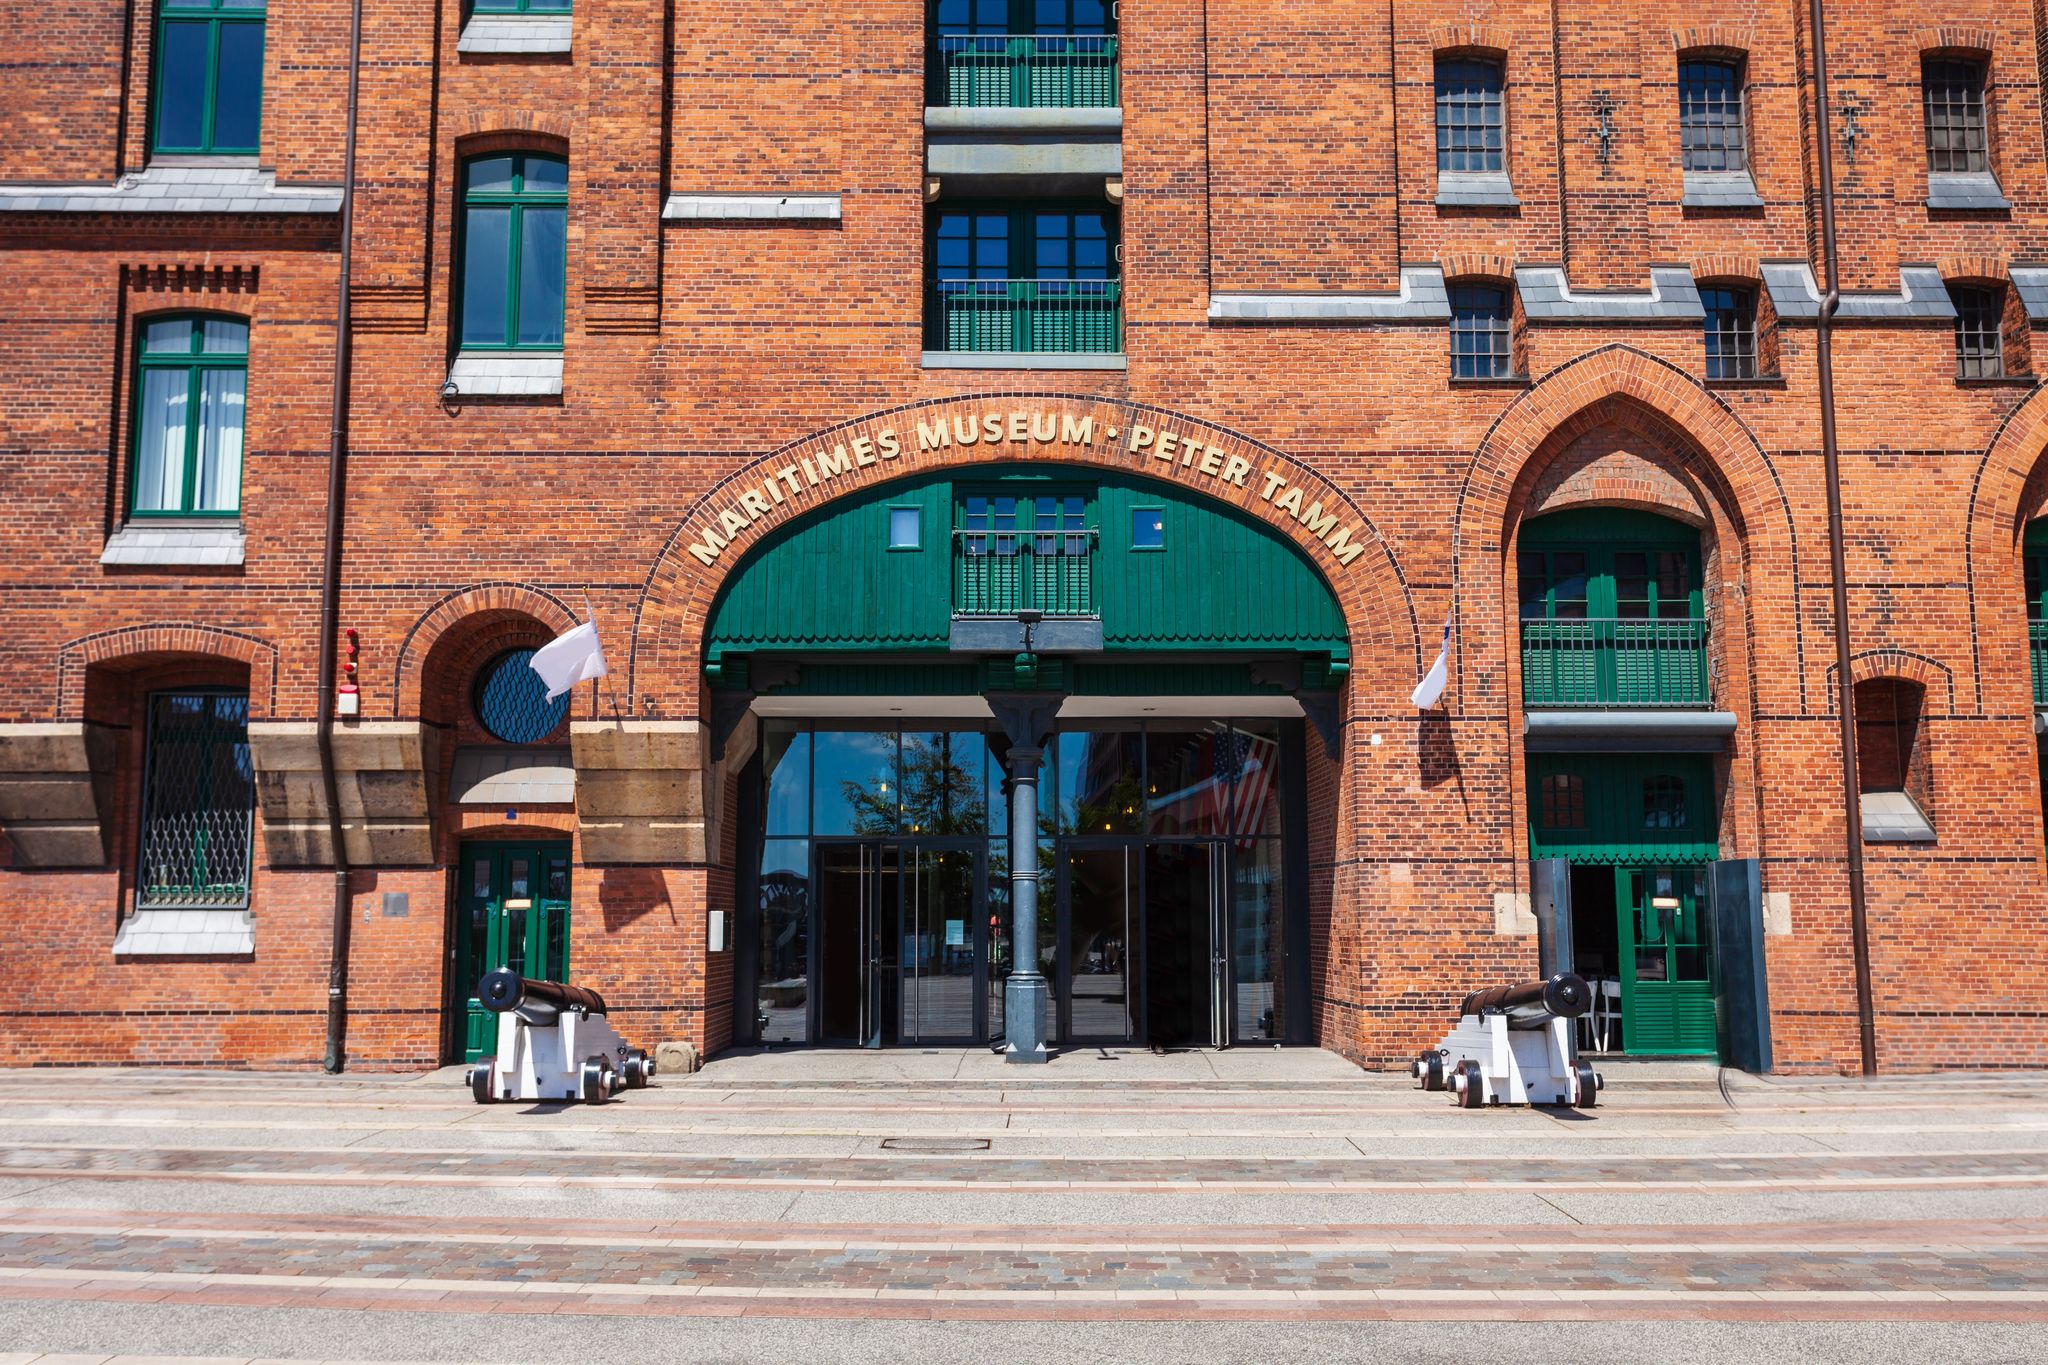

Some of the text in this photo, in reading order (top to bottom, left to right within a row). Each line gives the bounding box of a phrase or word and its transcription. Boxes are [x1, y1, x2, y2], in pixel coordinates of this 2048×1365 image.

[688, 413, 1364, 565] MARITIMES MUSEUM PETER TAMM
